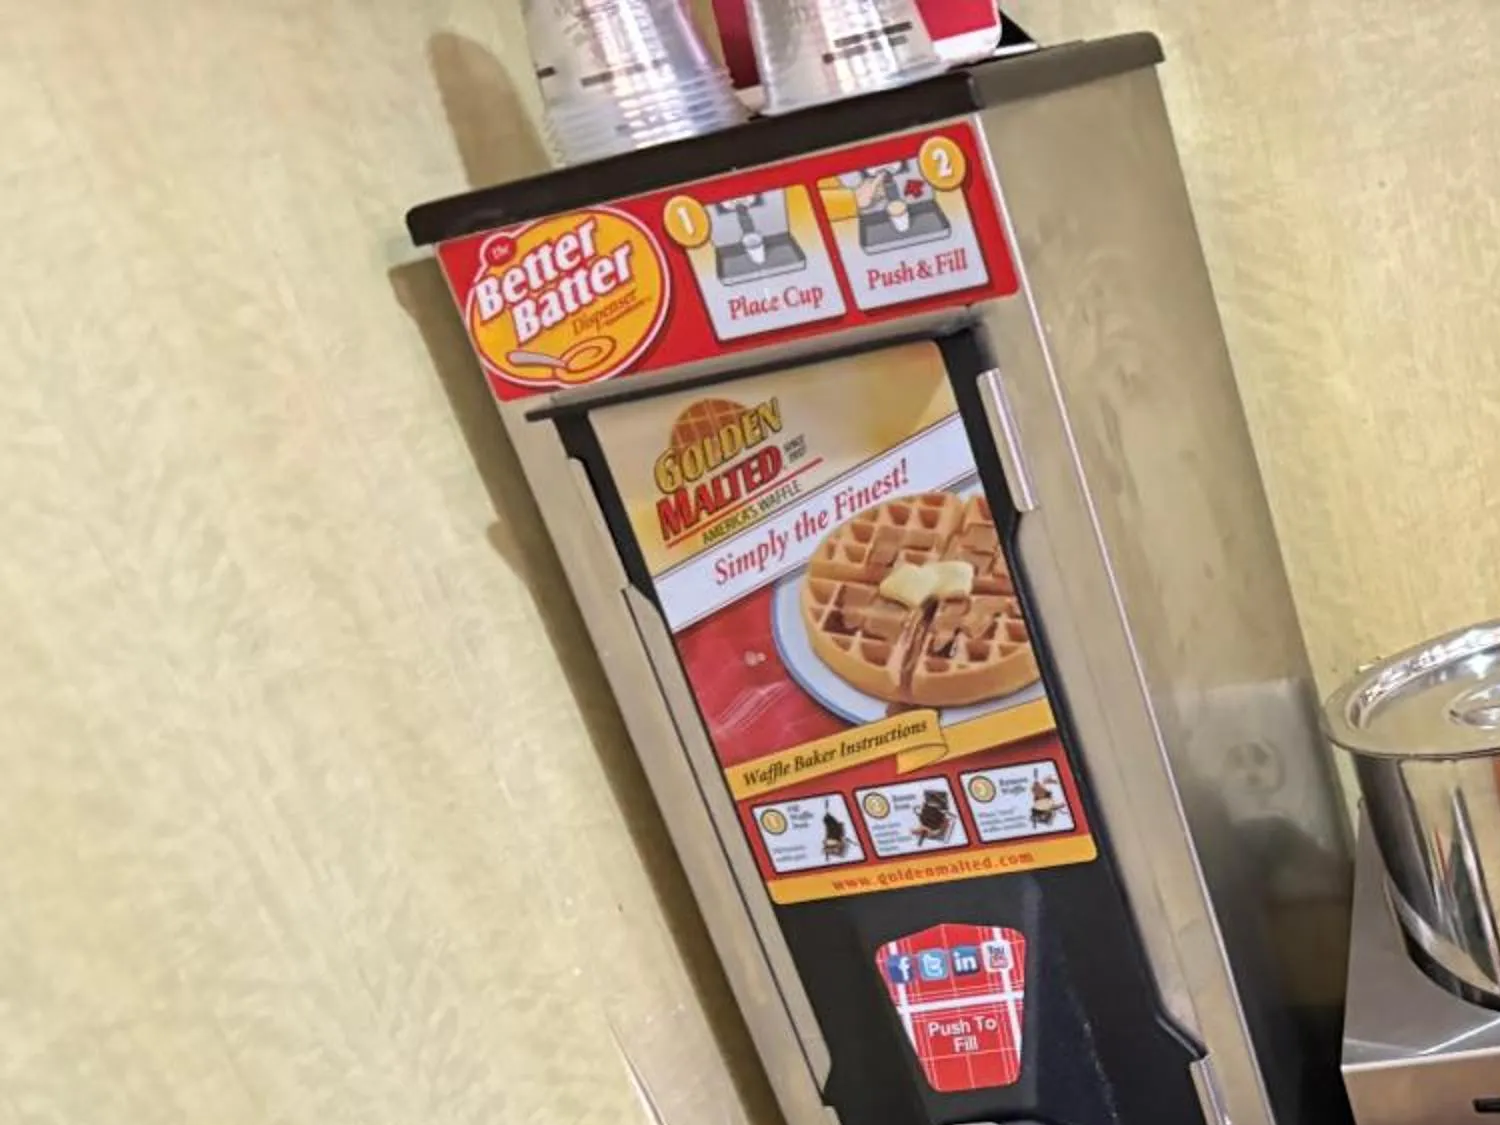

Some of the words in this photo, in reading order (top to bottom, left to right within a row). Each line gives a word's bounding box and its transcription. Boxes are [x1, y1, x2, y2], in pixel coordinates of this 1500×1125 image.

[931, 147, 953, 179] 2
[475, 217, 598, 323] Better
[511, 242, 632, 345] Batter
[866, 264, 916, 291] Push
[916, 259, 932, 279] &
[934, 247, 969, 274] Fill
[728, 289, 779, 321] Place
[783, 283, 824, 310] Cup
[654, 396, 783, 494] GOLDEN
[656, 445, 783, 541] MALTED
[759, 479, 802, 510] WAFFLE
[714, 528, 790, 586] Simply
[794, 508, 829, 543] the
[833, 457, 910, 521] Finest!
[742, 760, 790, 787] Waffle
[795, 748, 837, 771] Baker
[840, 719, 928, 758] Instructions
[928, 1019, 971, 1037] Push
[974, 1014, 998, 1032] To
[954, 1034, 979, 1053] Fill
